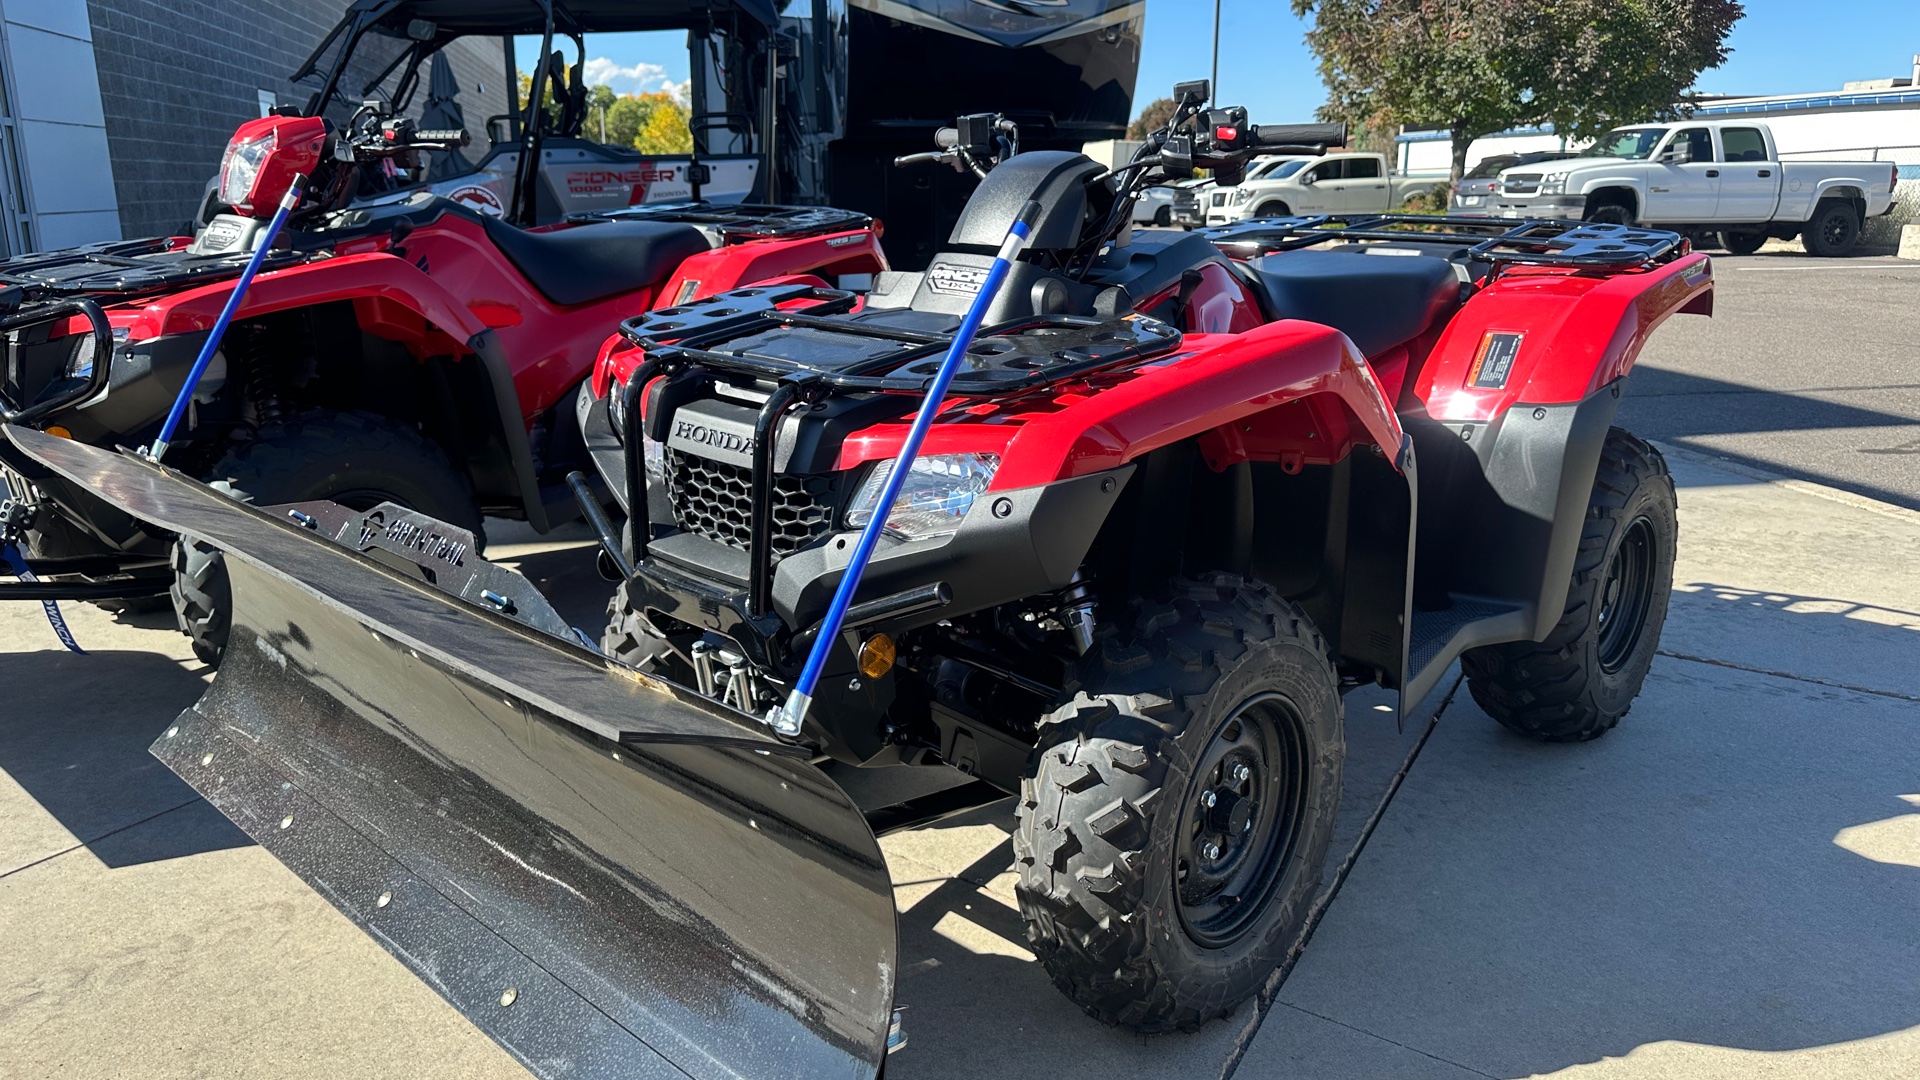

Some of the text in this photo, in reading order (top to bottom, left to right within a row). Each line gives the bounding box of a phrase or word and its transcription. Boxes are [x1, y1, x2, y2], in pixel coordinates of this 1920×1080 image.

[566, 169, 676, 185] PIONEER
[453, 188, 476, 199] HONDA
[476, 189, 497, 206] WORLD
[570, 185, 603, 193] 1000
[653, 190, 689, 199] HONDA
[928, 269, 991, 285] RANCHE
[675, 421, 755, 456] HONDA
